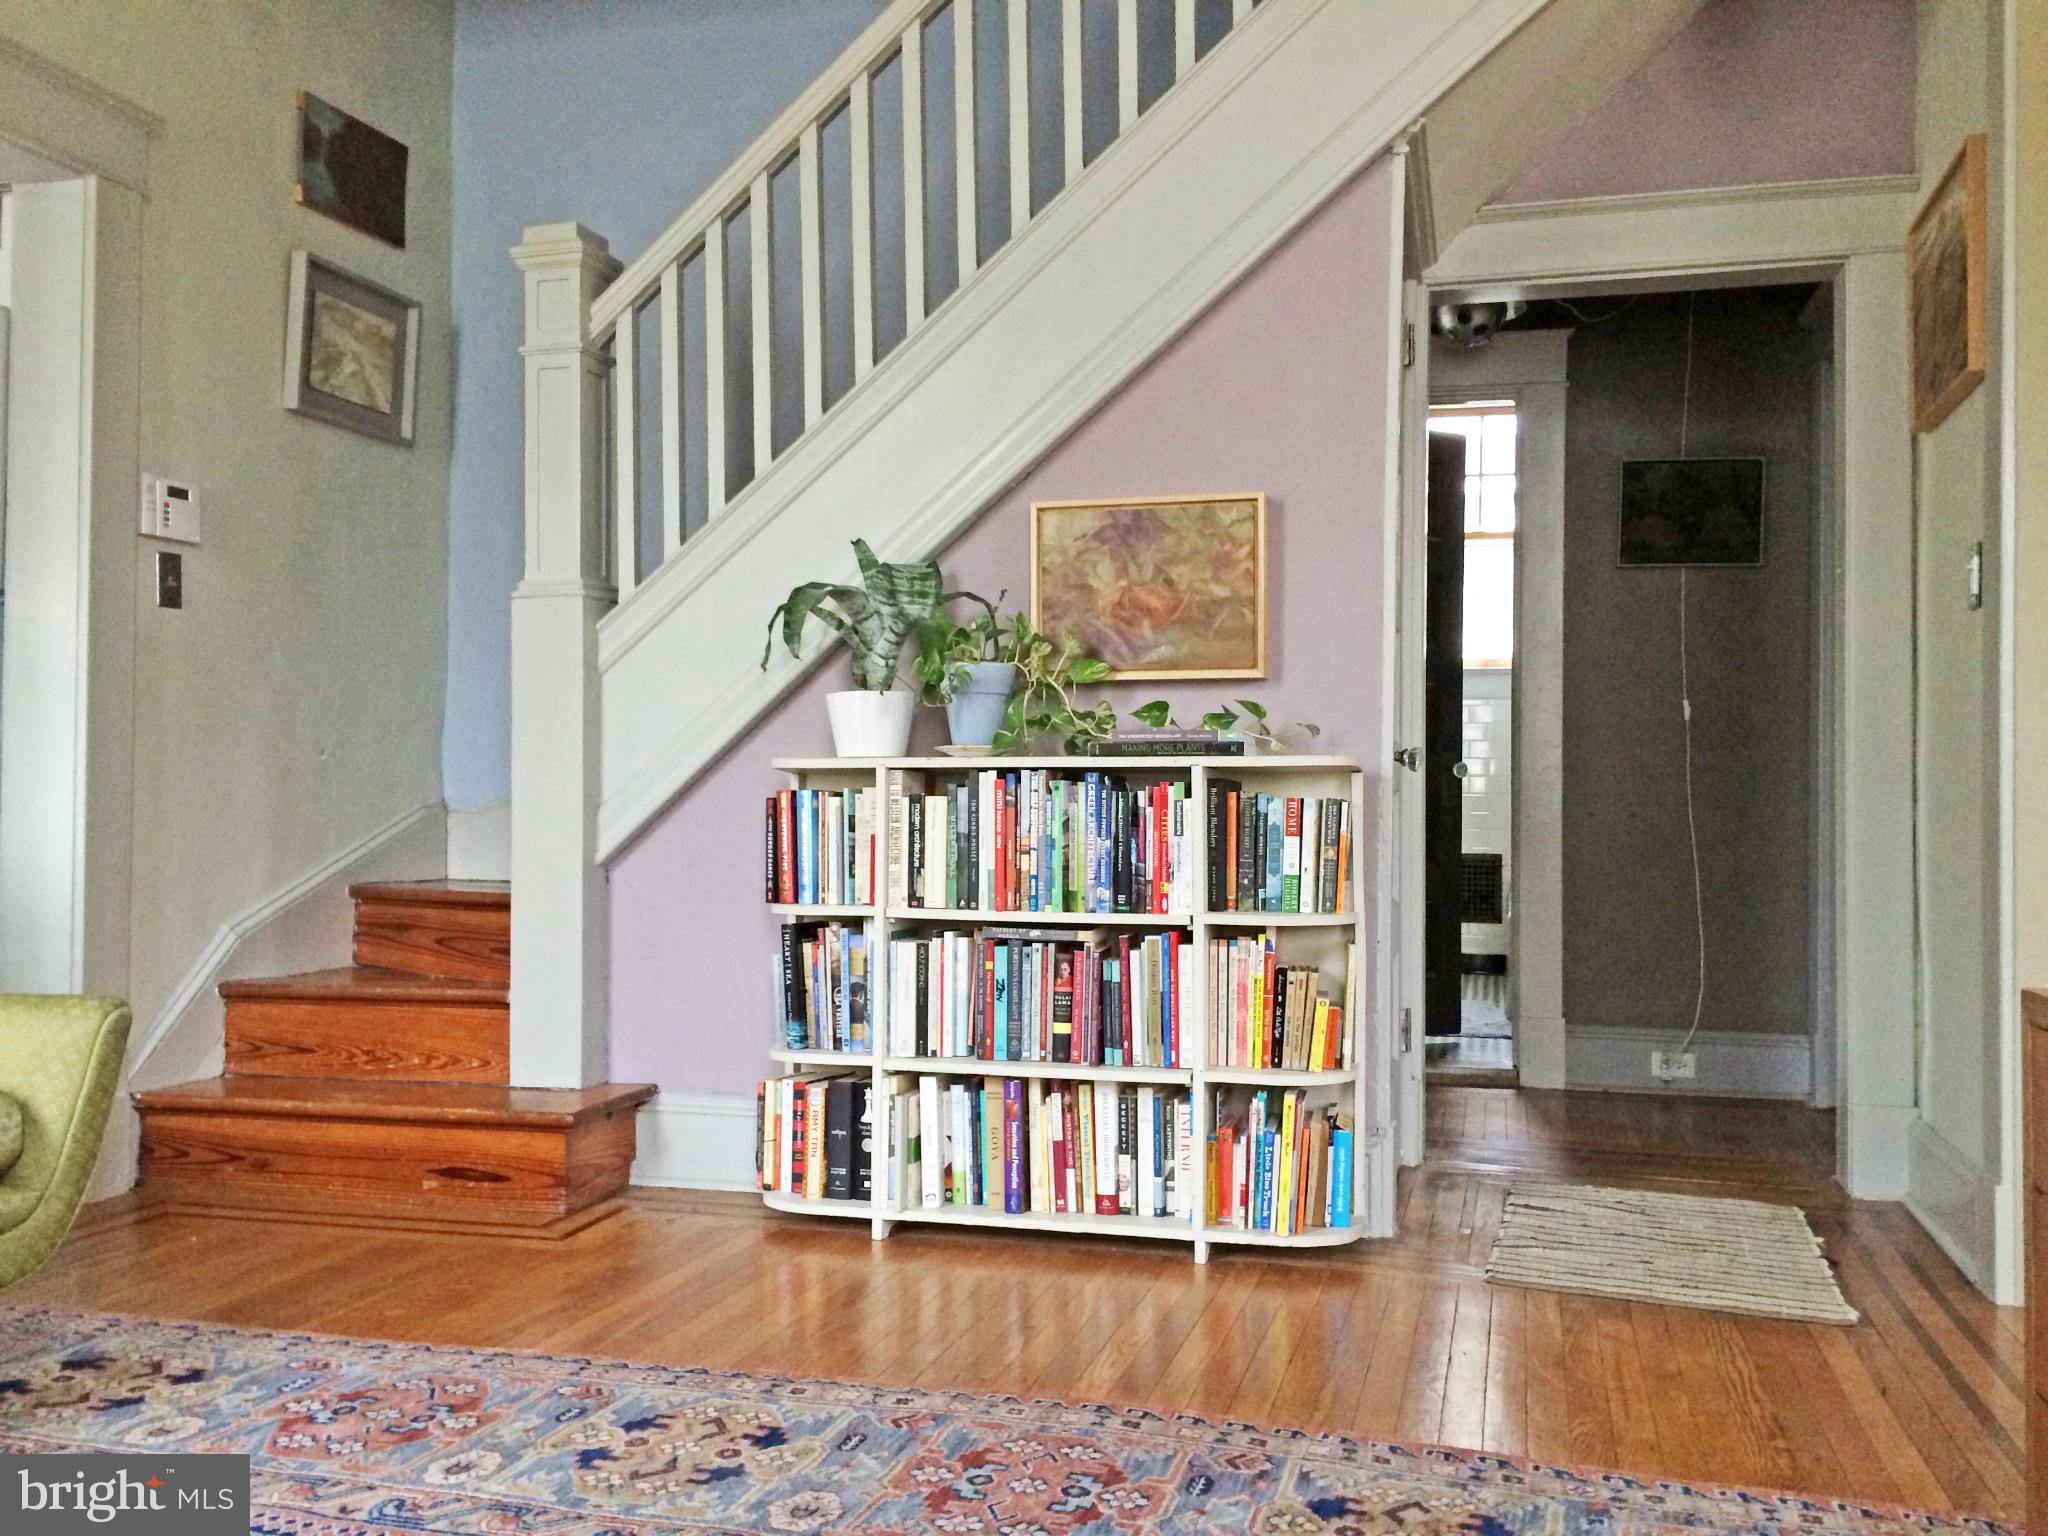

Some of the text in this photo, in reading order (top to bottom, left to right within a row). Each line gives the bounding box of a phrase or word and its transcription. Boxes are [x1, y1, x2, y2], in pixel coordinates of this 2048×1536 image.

[1210, 817, 1219, 848] Blunders
[1287, 801, 1297, 834] ROME
[1087, 783, 1096, 886] GREEN ARCHITECTURE
[783, 932, 791, 961] HEART
[785, 969, 793, 985] SEA
[810, 1110, 819, 1158] AMY TAN
[991, 1126, 1000, 1161] GOYA
[1010, 1121, 1019, 1189] Sensation and Perception
[1264, 1146, 1272, 1170] Little
[1262, 1190, 1271, 1217] Truck
